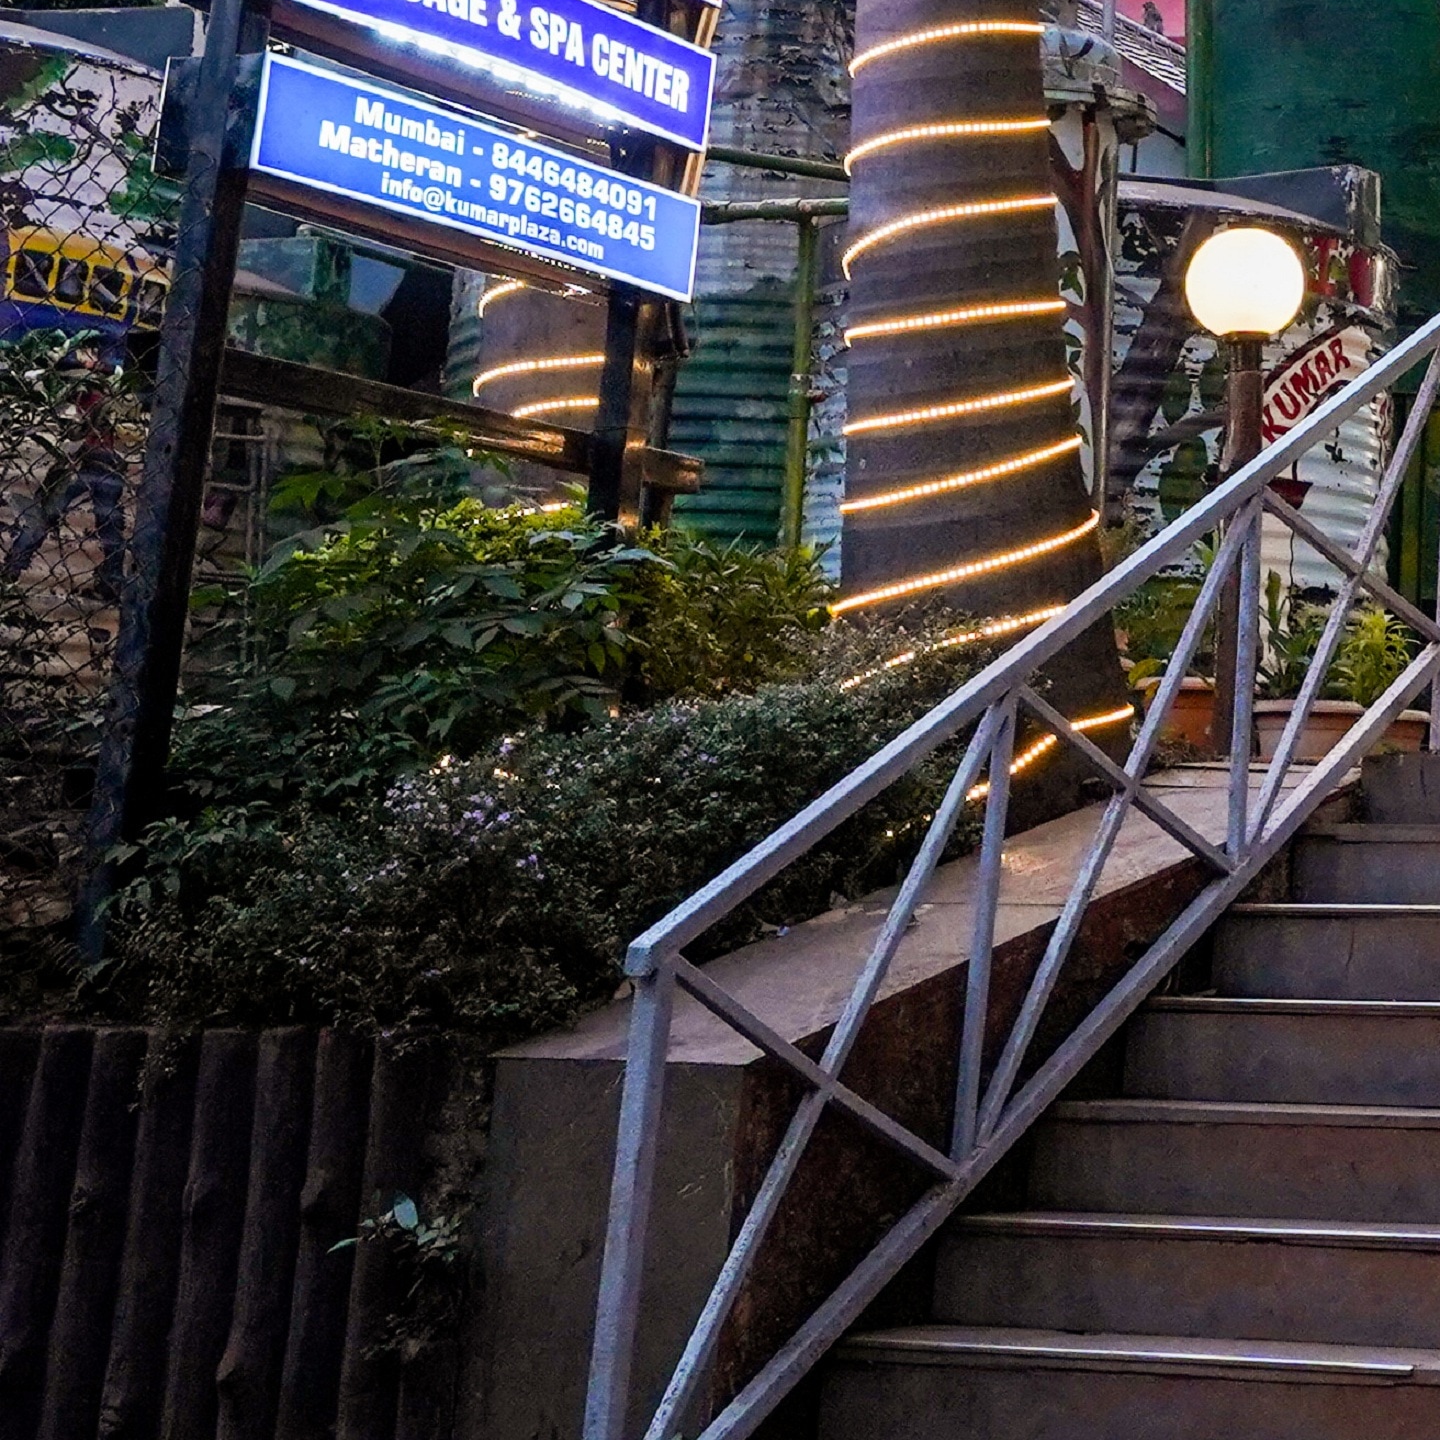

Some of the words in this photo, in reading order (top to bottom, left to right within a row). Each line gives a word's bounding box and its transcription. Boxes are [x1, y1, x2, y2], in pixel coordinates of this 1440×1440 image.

[529, 7, 585, 63] SPA
[591, 33, 690, 113] CENTER
[318, 120, 461, 188] Matheran
[489, 174, 655, 251] 9762664845
[354, 96, 465, 155] Mumbai
[491, 142, 656, 221] 8446484091
[381, 171, 604, 260] info@kumarplaza.com
[1262, 337, 1351, 444] KUMAR
